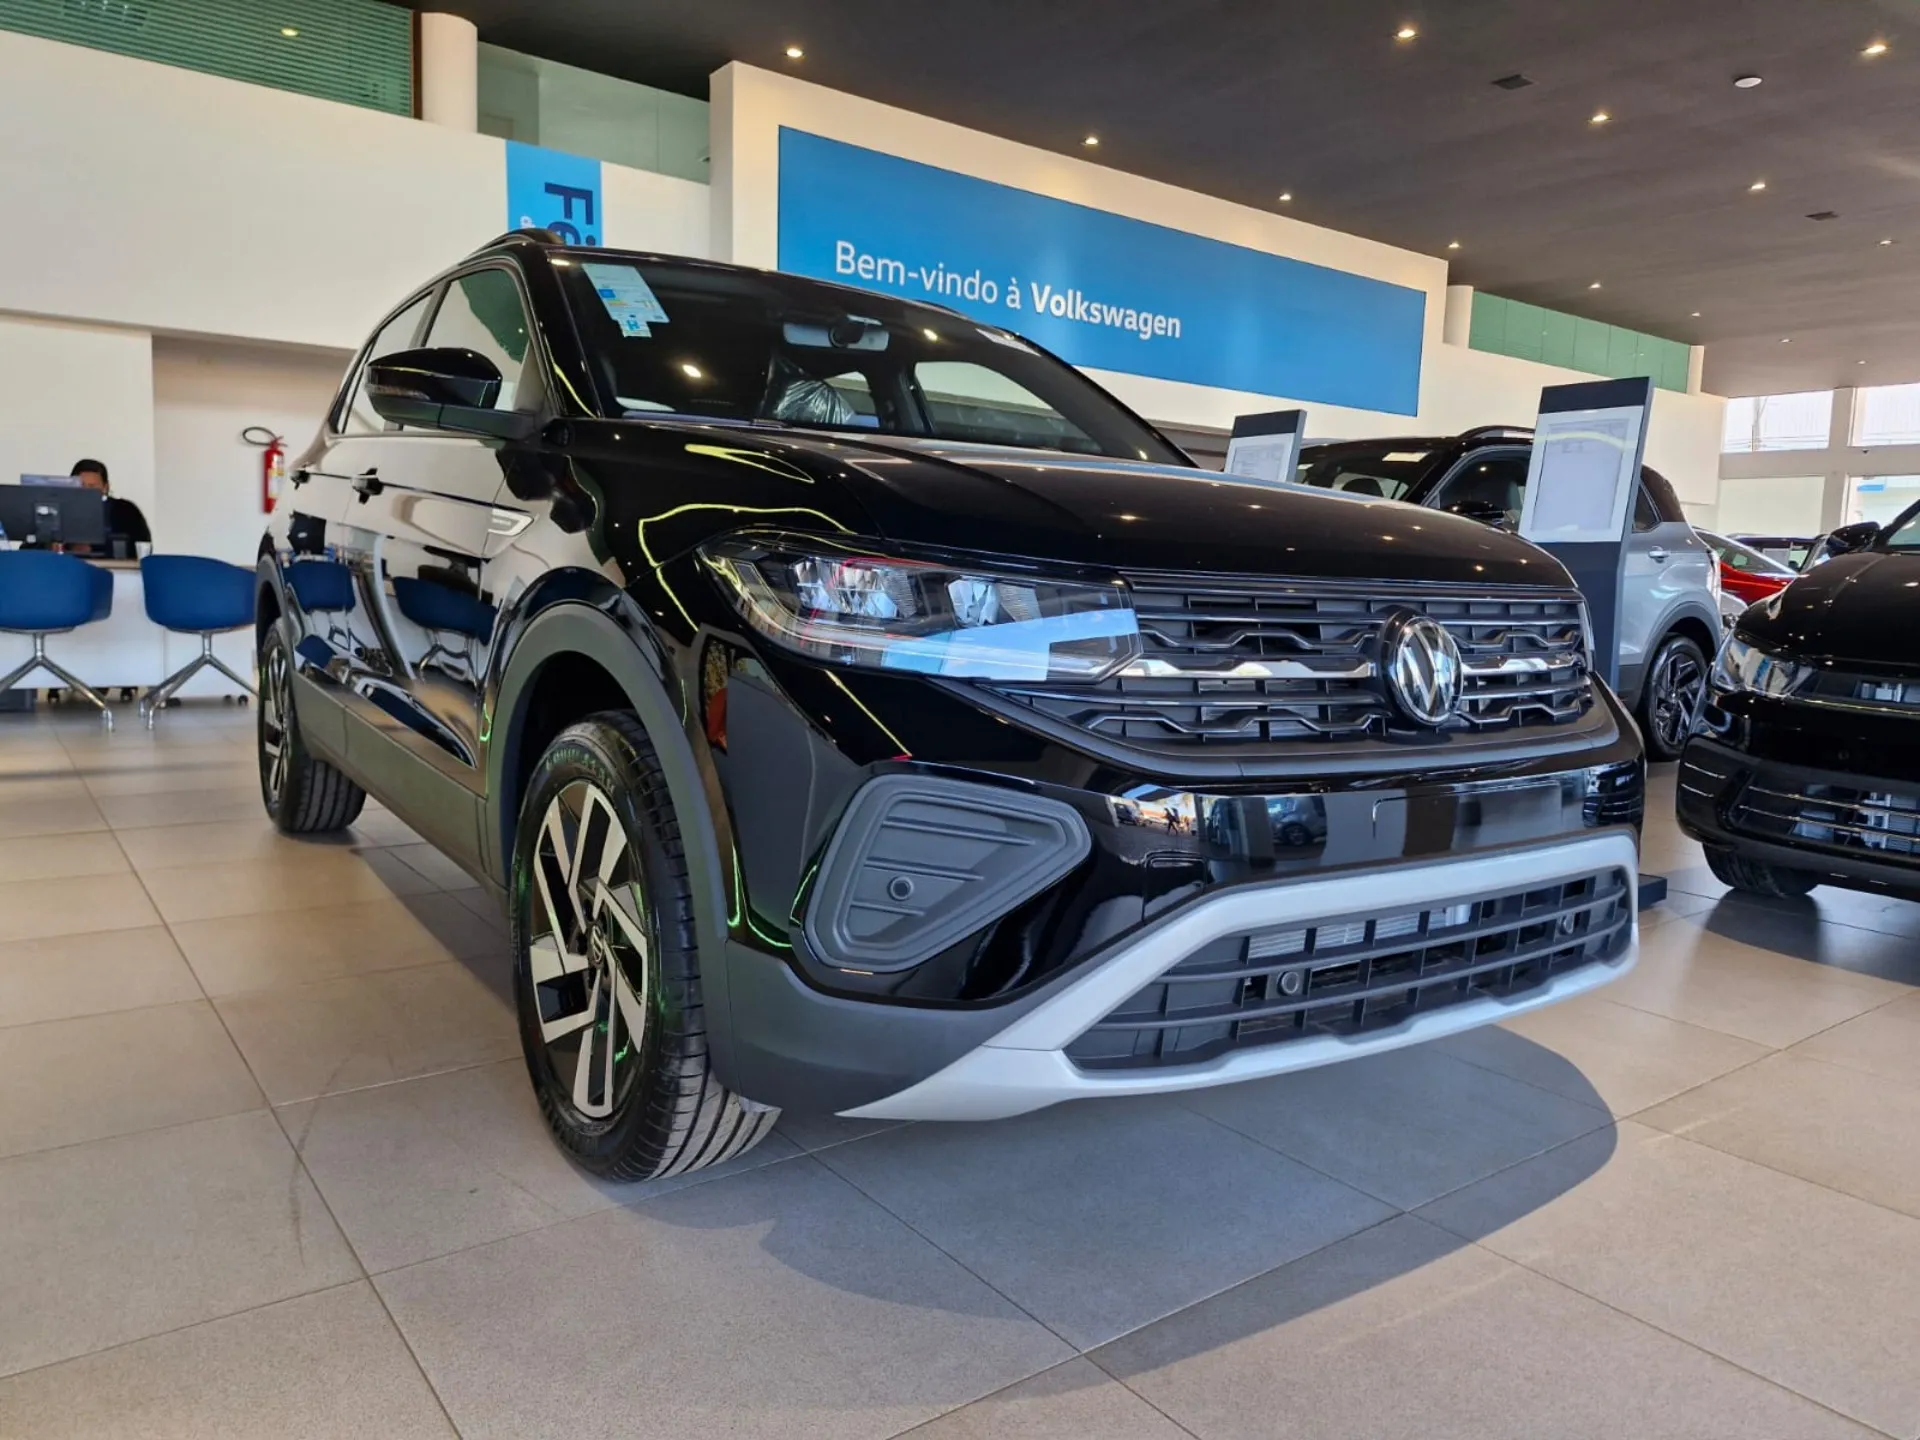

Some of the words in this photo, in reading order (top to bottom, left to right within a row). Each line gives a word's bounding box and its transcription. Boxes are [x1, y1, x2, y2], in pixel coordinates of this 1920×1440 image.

[835, 240, 998, 304] Bem-vindo
[1006, 276, 1021, 310] à
[1030, 282, 1181, 340] Volkswagen
